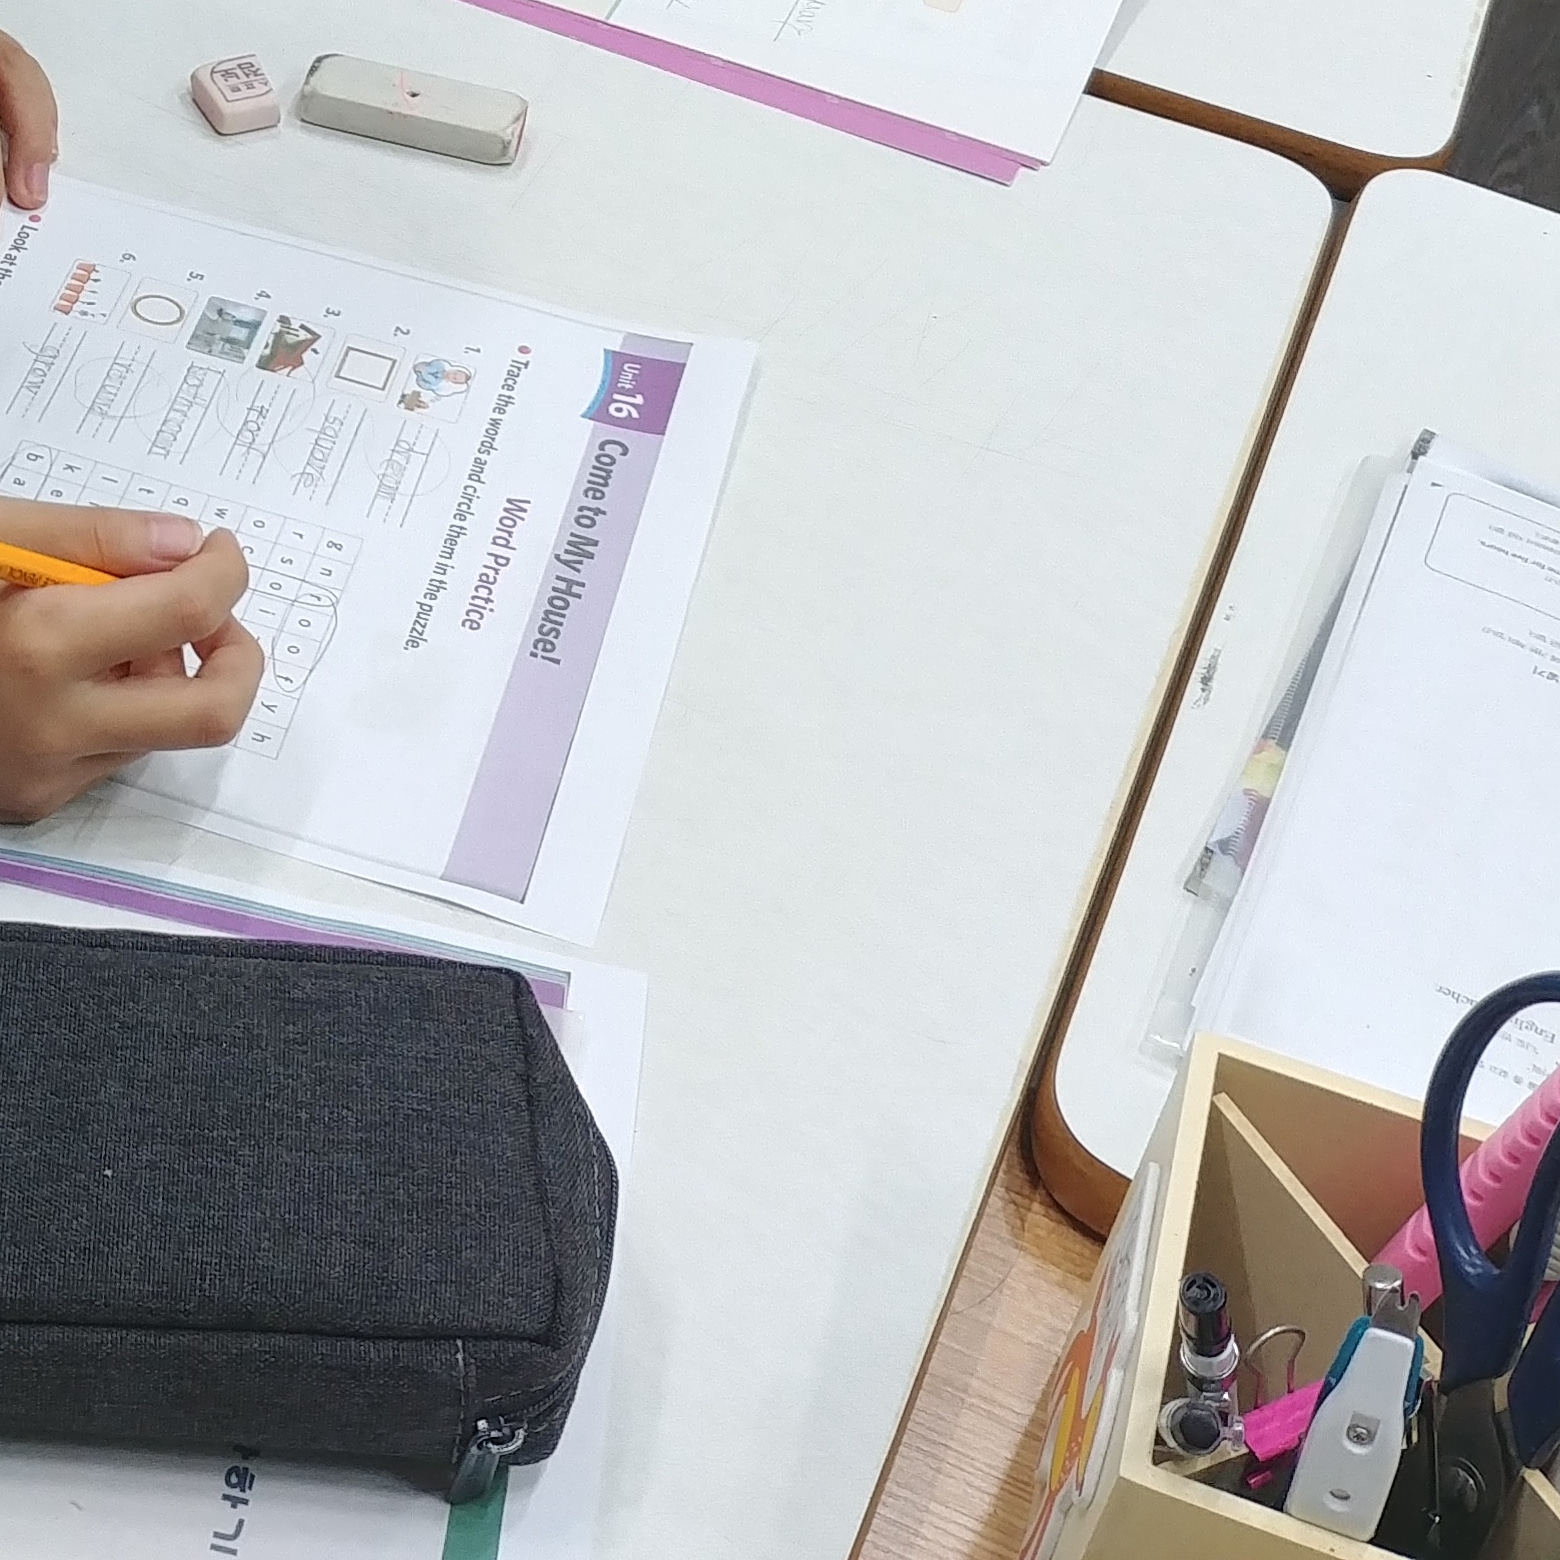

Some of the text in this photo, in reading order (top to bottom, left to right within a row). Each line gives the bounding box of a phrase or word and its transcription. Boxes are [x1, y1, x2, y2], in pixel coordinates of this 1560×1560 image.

[10, 225, 39, 255] Look
[3, 251, 18, 268] at
[119, 252, 137, 264] 6.
[186, 270, 205, 283] 5.
[254, 289, 272, 301] 4.
[323, 307, 341, 318] 3.
[393, 326, 411, 337] 2.
[464, 344, 482, 354] 1.
[500, 358, 531, 396] Trace
[607, 362, 645, 420] Unit 16
[492, 394, 516, 417] the
[478, 414, 509, 457] words
[13, 451, 44, 487] b a
[467, 454, 488, 485] and
[50, 463, 82, 499] k e
[138, 487, 155, 497] t
[172, 496, 189, 508] q
[453, 483, 482, 524] circle
[213, 507, 229, 520] w
[252, 519, 266, 529] o
[291, 531, 304, 540] r
[438, 520, 468, 560] them
[326, 539, 345, 553] g
[529, 438, 630, 666] Come to My House!
[280, 555, 293, 566] s
[433, 559, 456, 576] in
[460, 495, 532, 632] Word Practice
[319, 565, 333, 578] n
[269, 581, 283, 591] o
[422, 577, 448, 601] the
[298, 617, 312, 629] o
[287, 644, 300, 656] o
[275, 672, 294, 685] f
[259, 700, 279, 715] y
[251, 731, 272, 745] h
